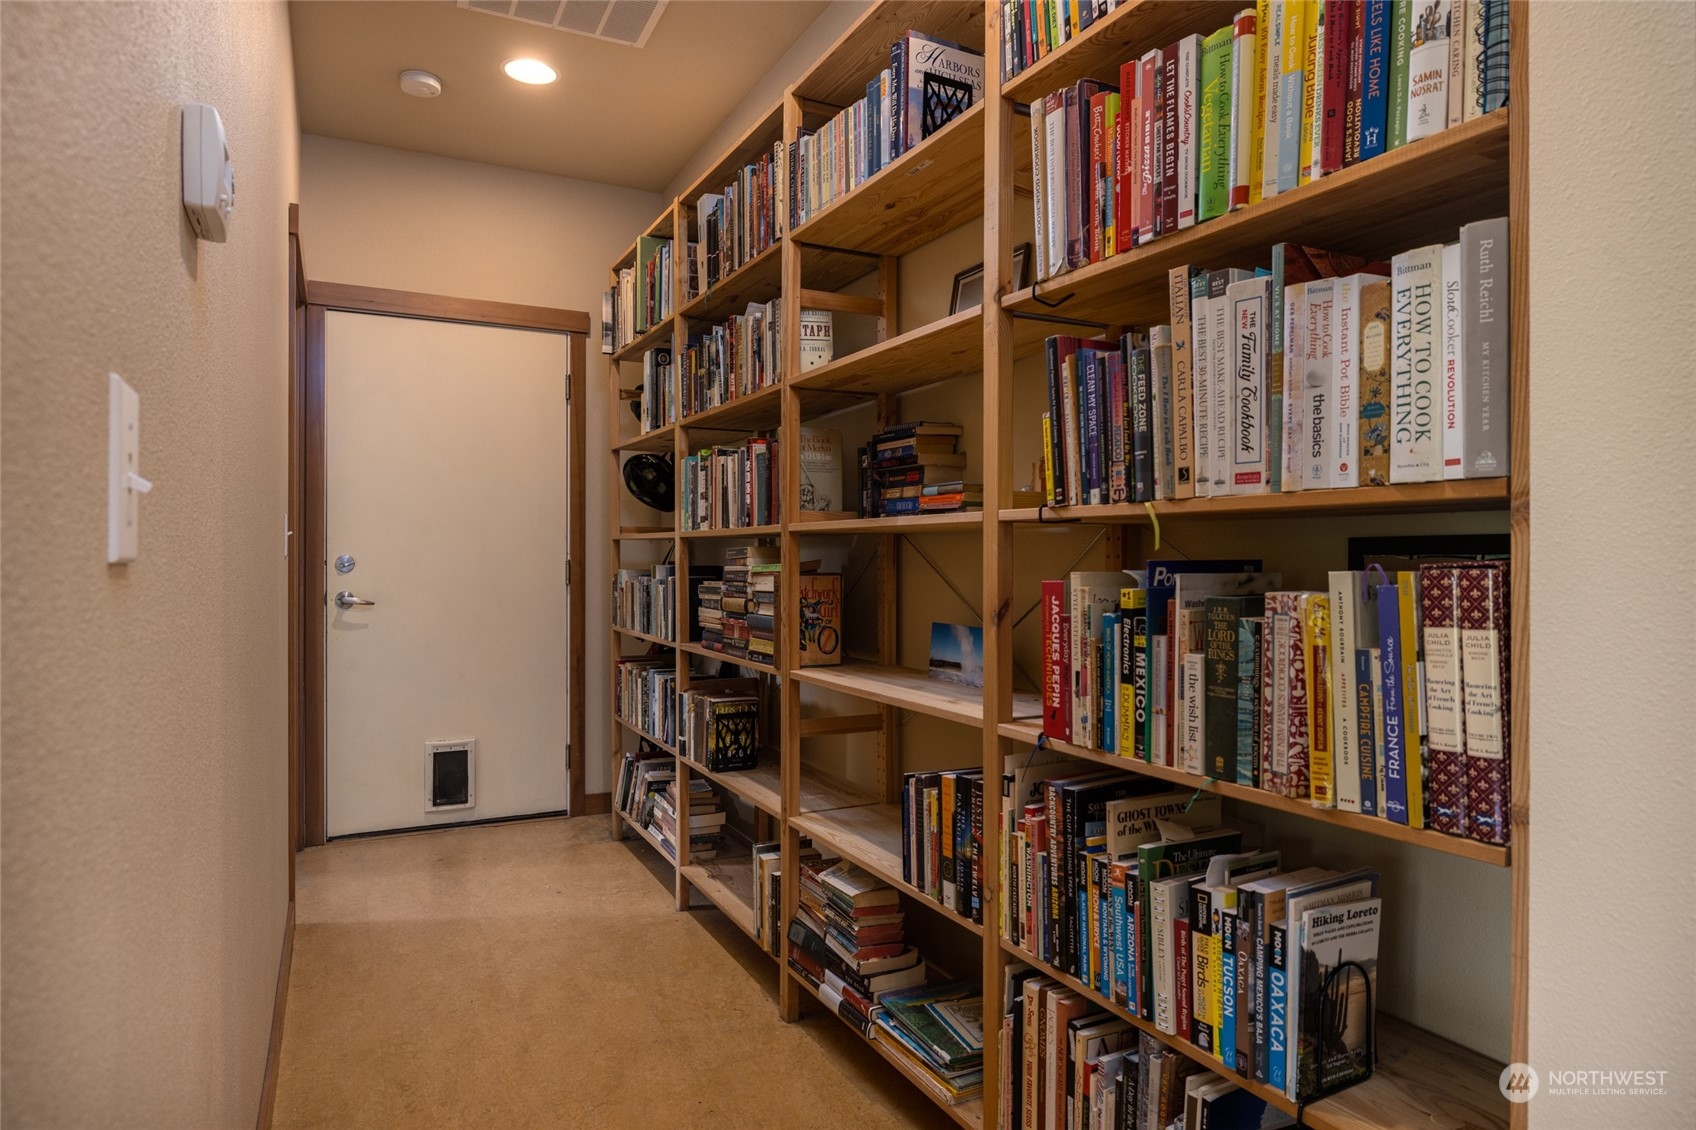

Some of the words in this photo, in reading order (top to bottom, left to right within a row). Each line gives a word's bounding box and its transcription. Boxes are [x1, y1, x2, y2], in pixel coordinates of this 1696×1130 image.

[1290, 15, 1298, 34] How
[1289, 36, 1296, 46] to
[914, 42, 981, 80] HARBORS
[1220, 53, 1230, 80] How
[1288, 47, 1296, 70] Cook
[1220, 83, 1228, 92] to
[1286, 74, 1295, 109] Without
[1410, 81, 1444, 100] NOSRAT
[1412, 69, 1442, 87] SAMIN
[1092, 105, 1102, 128] Betty
[1166, 98, 1174, 140] FLAMES
[1218, 90, 1230, 121] Cook
[1346, 101, 1354, 127] FOOD
[1201, 77, 1218, 174] Vegetarian
[1285, 117, 1294, 140] Book
[1354, 98, 1362, 158] REVOLUTION
[1166, 142, 1174, 176] BEGIN
[1214, 124, 1230, 190] Everything
[1397, 263, 1432, 276] Bittman
[1480, 239, 1494, 274] Ruth
[1175, 274, 1185, 325] ITALIAN
[1342, 282, 1350, 302] the
[1446, 281, 1459, 311] Slow
[1480, 278, 1494, 324] Reichl
[1216, 306, 1225, 328] THE
[1274, 309, 1280, 320] AT
[1322, 300, 1333, 321] How
[1415, 282, 1432, 336] HOW
[1197, 315, 1206, 337] THE
[1216, 330, 1225, 354] BEST
[1306, 303, 1320, 360] Everything
[1322, 323, 1331, 332] to
[1341, 307, 1350, 354] Instant
[1446, 309, 1459, 356] Cooker
[1198, 339, 1206, 364] BEST
[1238, 332, 1257, 382] Family
[1322, 332, 1332, 358] Cook
[1416, 342, 1432, 374] TO
[1482, 342, 1490, 356] MY
[1086, 364, 1096, 392] CLEAN
[1176, 360, 1186, 402] CARLA
[1341, 359, 1350, 380] Pot
[1396, 287, 1412, 445] EVERYTHING
[1482, 360, 1490, 402] KITCHEN
[1088, 394, 1096, 408] MY
[1138, 374, 1146, 400] FEED
[1198, 365, 1208, 421] 30-MINUTE
[1216, 356, 1226, 424] MAKE-AHEAD
[1340, 385, 1350, 418] Bible
[1446, 360, 1456, 430] REVOLUTION
[1138, 403, 1146, 432] ZONE
[1240, 386, 1258, 454] Cookbook
[1313, 394, 1324, 414] the
[1415, 380, 1432, 444] COOK
[1482, 406, 1490, 432] YEAR
[1088, 410, 1097, 438] SPACE
[1178, 406, 1188, 461] CAPALBO
[1312, 416, 1324, 458] basics
[1200, 423, 1208, 458] RECIPE
[1218, 426, 1226, 461] RECIPE
[1052, 595, 1060, 661] JACQUES
[1208, 628, 1235, 643] LORD
[1214, 621, 1228, 630] THE
[1426, 632, 1449, 640] JULIA
[1062, 622, 1070, 664] Everyday
[1123, 618, 1131, 674] Electronics
[1208, 648, 1235, 661] RINGS
[1045, 632, 1053, 706] TECHNIQUES
[1188, 673, 1198, 694] the
[1052, 665, 1060, 708] PEPIN
[1136, 652, 1146, 723] MEXICO
[716, 705, 758, 715] JUSTIN
[1188, 696, 1198, 723] wish
[1358, 684, 1369, 735] CAMPFIRE
[1189, 725, 1198, 743] list
[1361, 738, 1372, 780] CUISINE
[1048, 786, 1057, 838] BACKCOUNTRY
[1117, 807, 1152, 824] GHOST
[1117, 825, 1126, 837] of
[1128, 823, 1142, 834] the
[1050, 838, 1058, 886] ADVENTURES
[1114, 896, 1124, 952] Southwest
[1224, 917, 1232, 950] MOON
[1312, 913, 1344, 929] Hiking
[1346, 906, 1378, 920] Loreto
[1127, 915, 1135, 962] ARIZONA
[1274, 930, 1282, 966] MOON
[1116, 953, 1124, 975] USA
[1180, 968, 1188, 986] Puget
[1196, 954, 1209, 987] Birds
[1224, 957, 1234, 1018] TUCSON
[1256, 980, 1264, 1021] MEXICO'S
[1180, 1008, 1188, 1030] Region
[1270, 972, 1284, 1052] OAXACA
